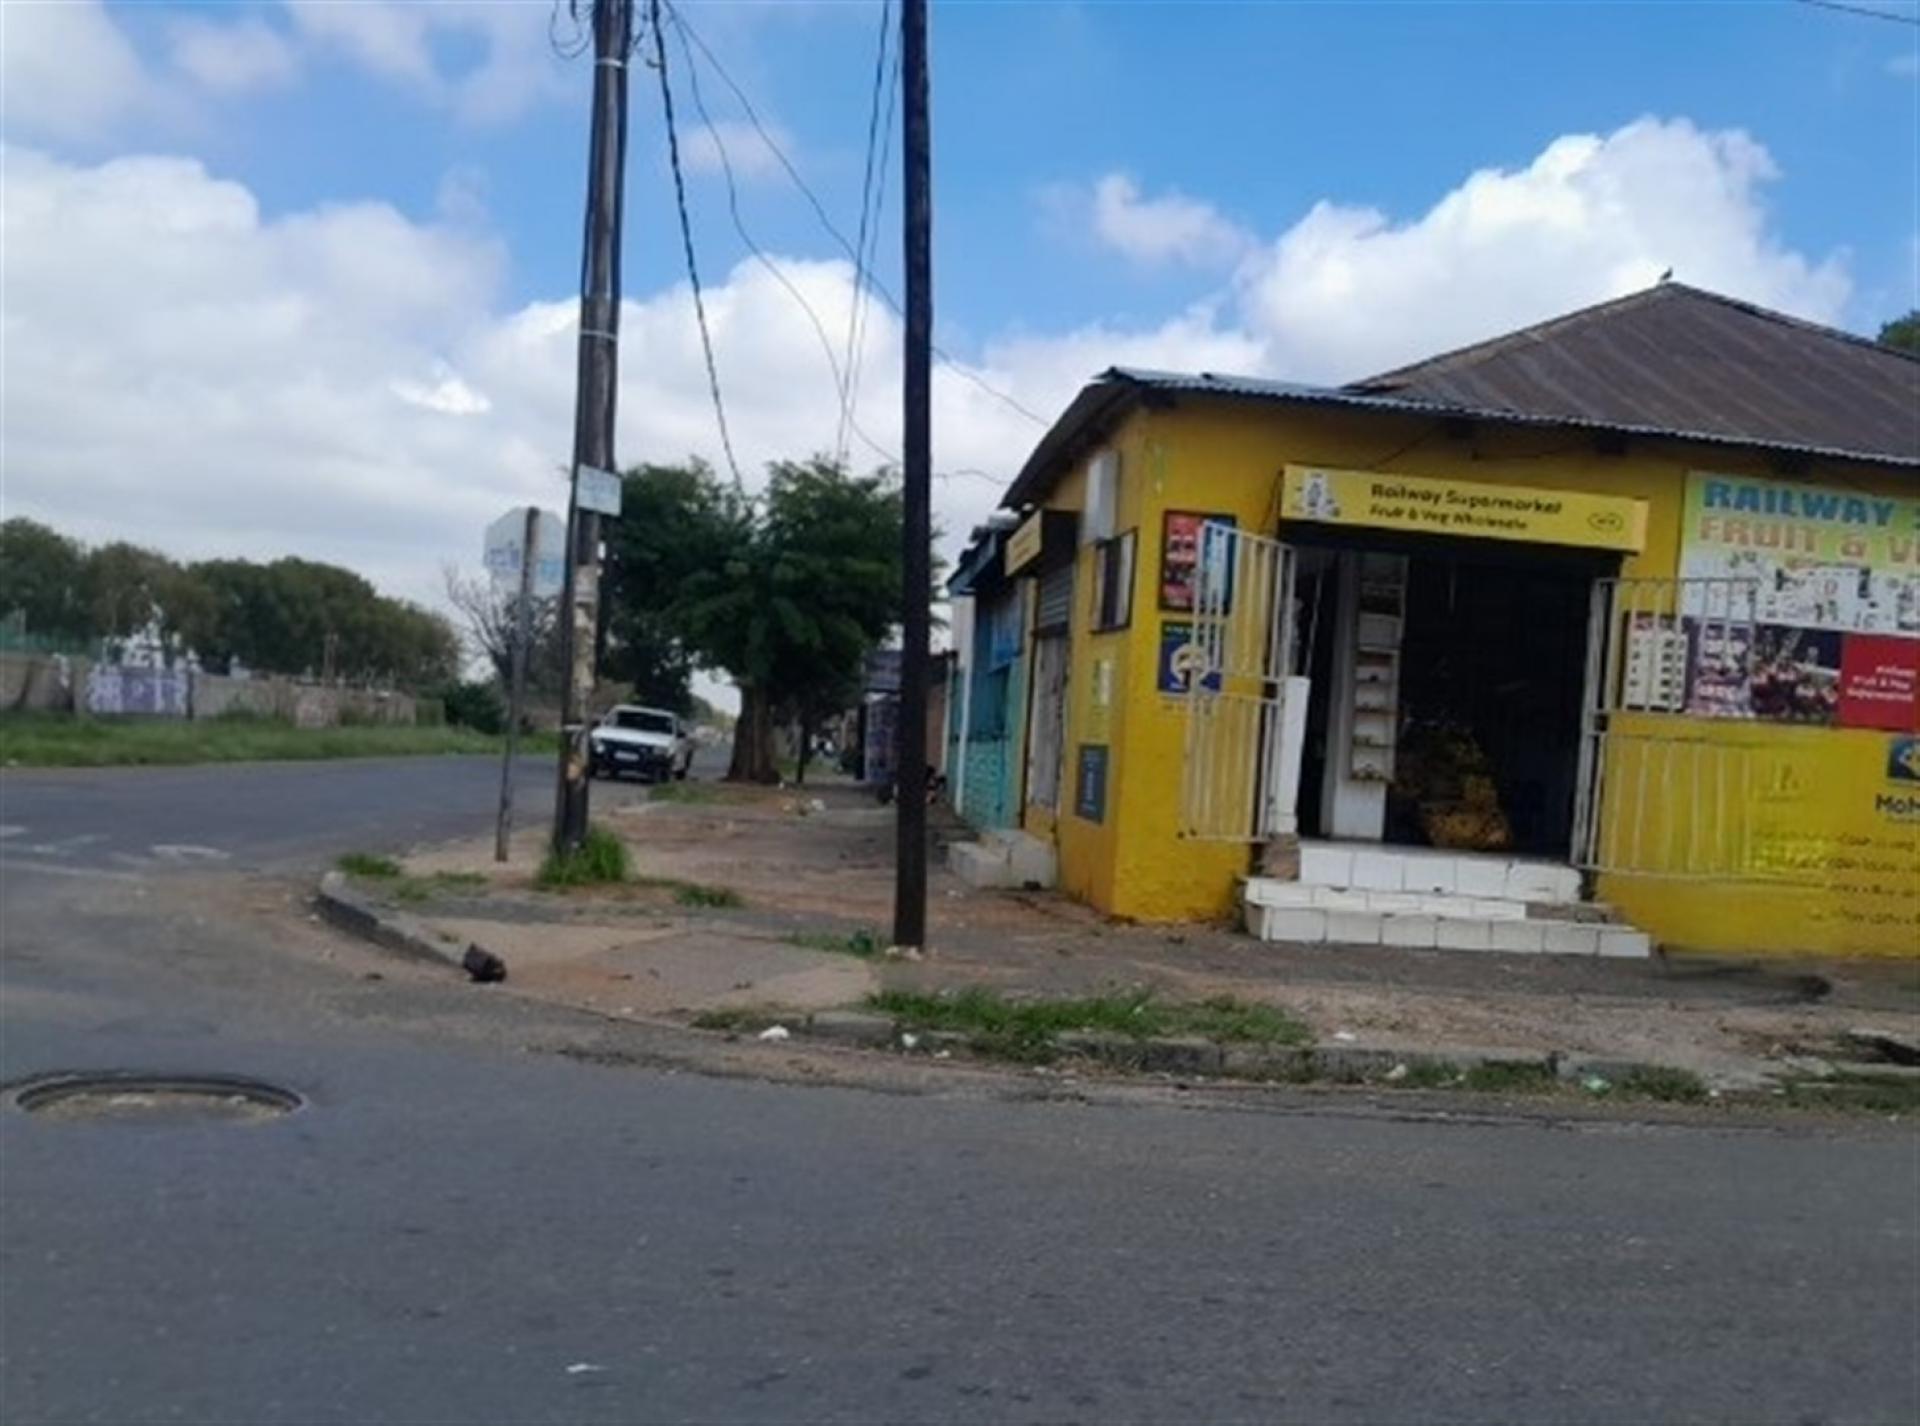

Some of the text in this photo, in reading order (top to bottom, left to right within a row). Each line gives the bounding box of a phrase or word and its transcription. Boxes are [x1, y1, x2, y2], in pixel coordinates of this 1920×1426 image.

[1371, 484, 1562, 515] Railway Supermarket
[1704, 480, 1895, 526] RAILWAY
[1701, 516, 1822, 552] FRUIT
